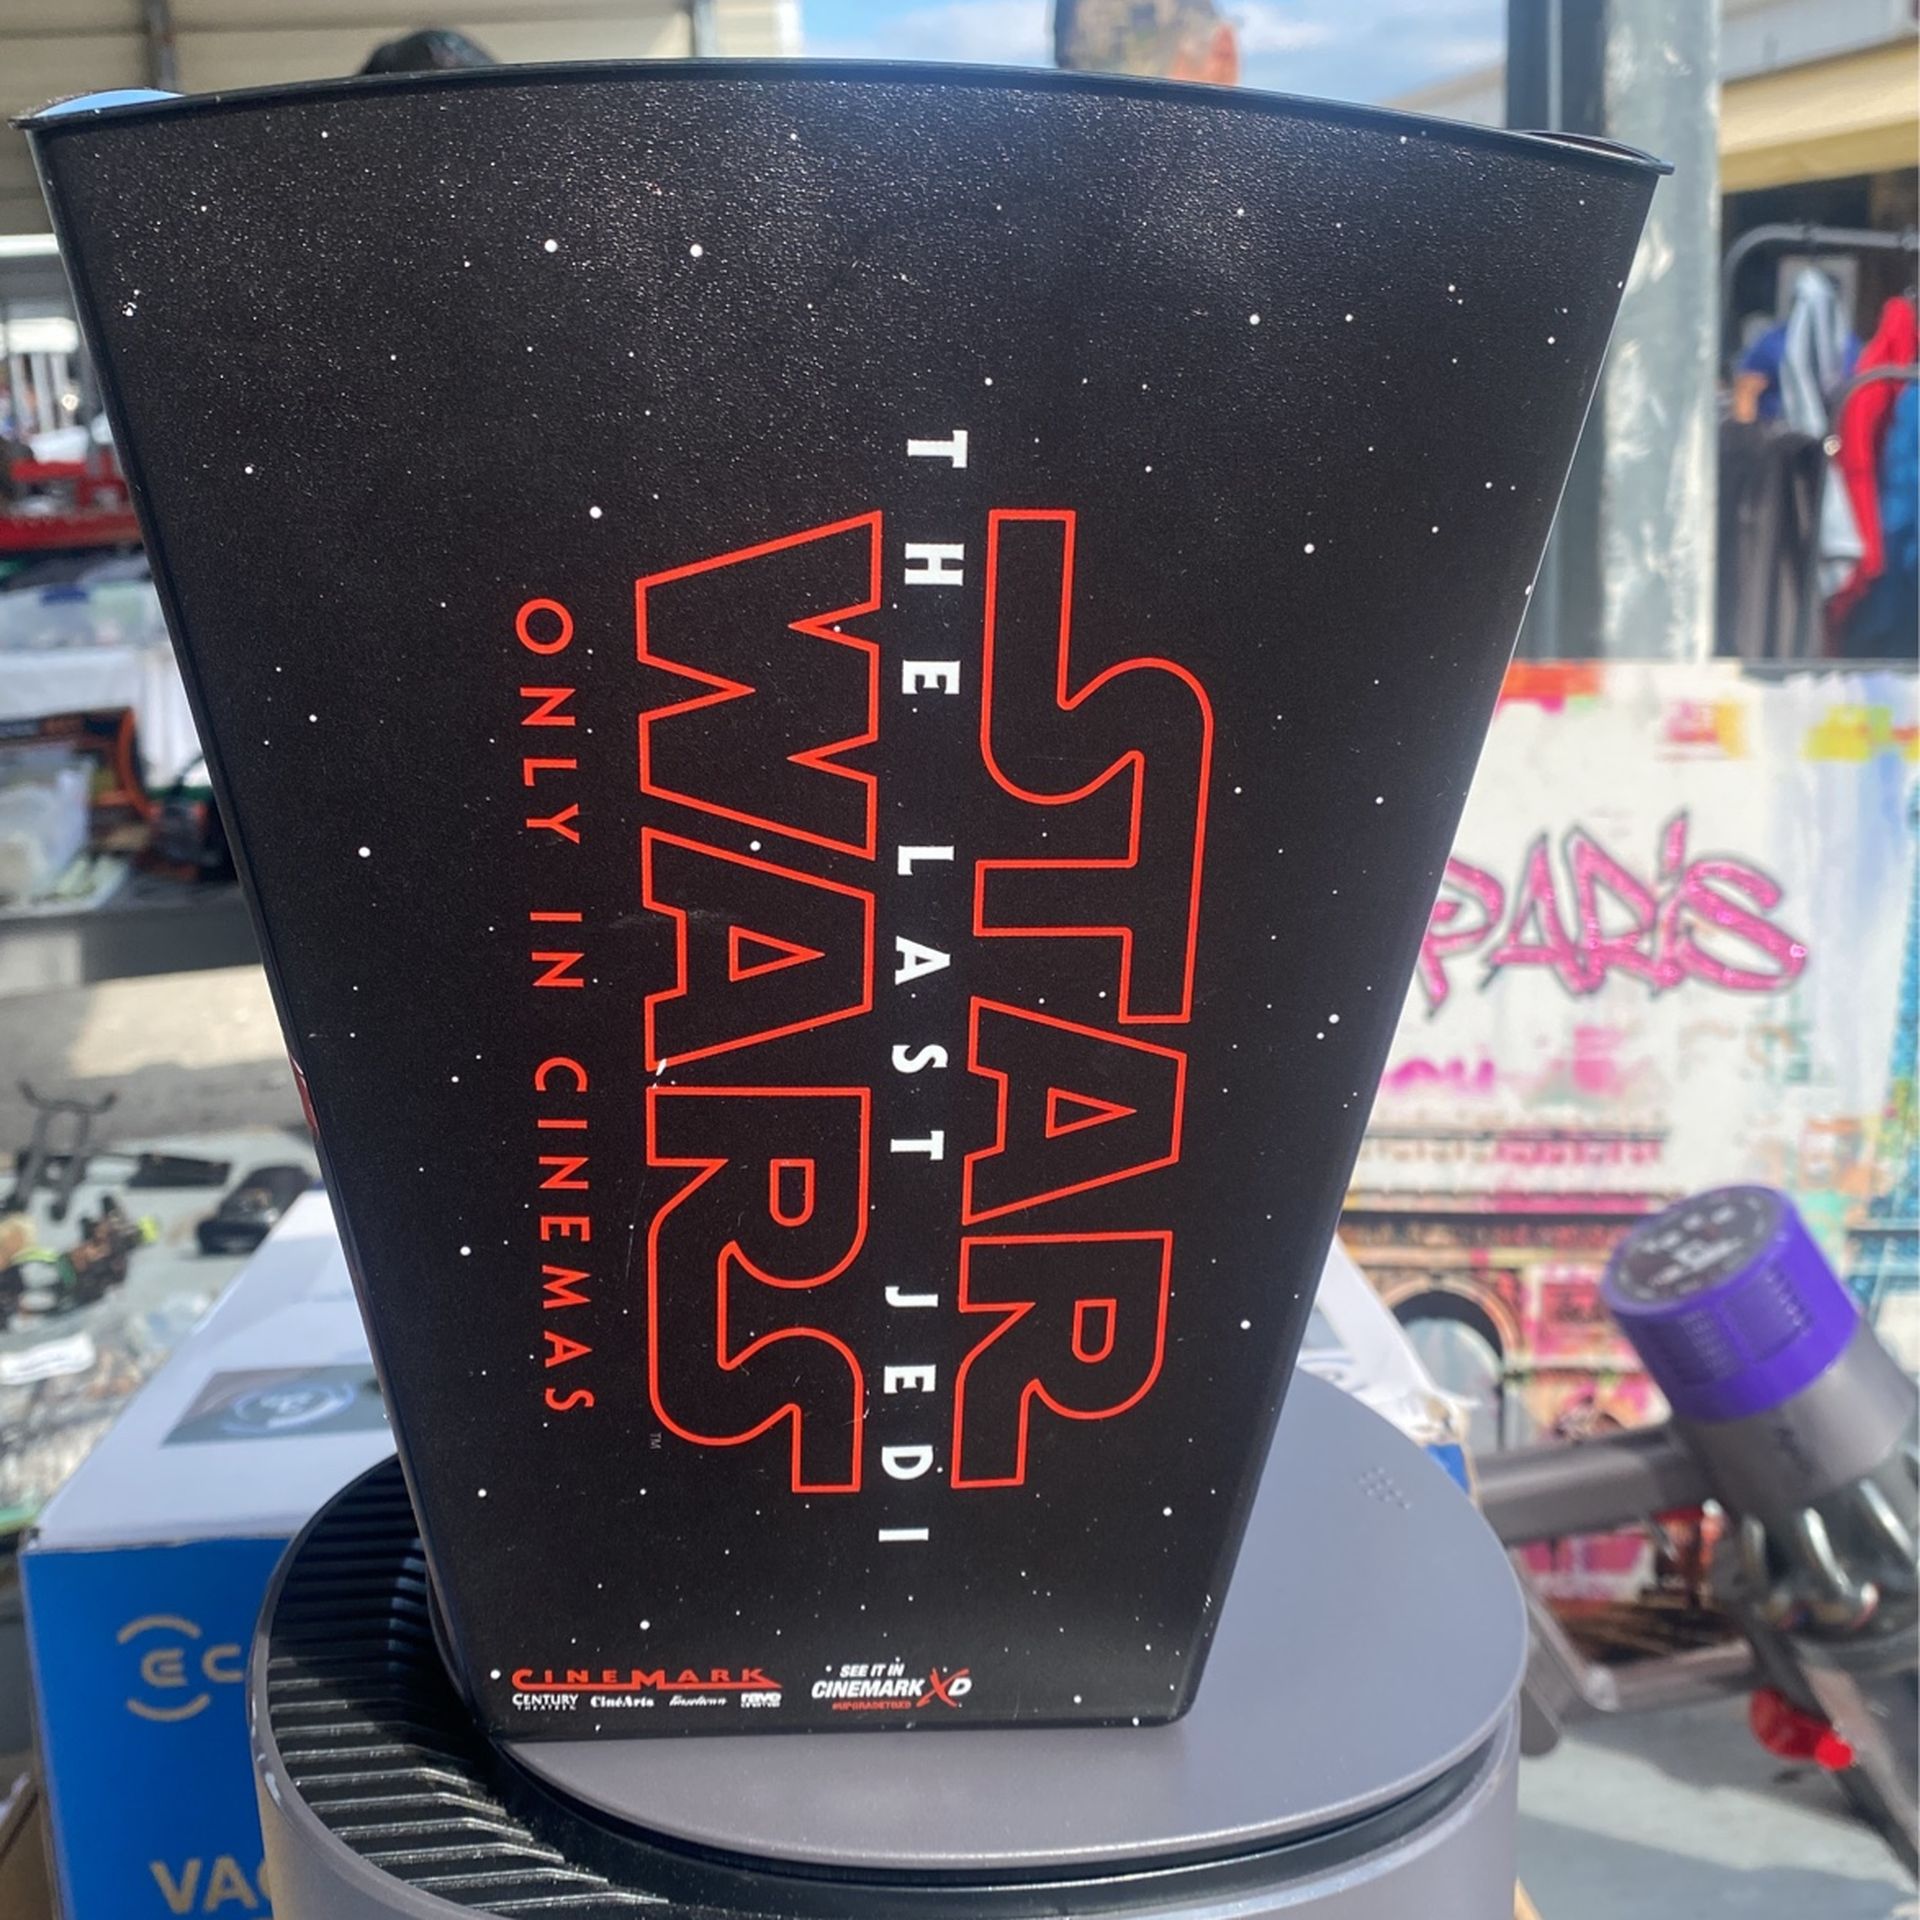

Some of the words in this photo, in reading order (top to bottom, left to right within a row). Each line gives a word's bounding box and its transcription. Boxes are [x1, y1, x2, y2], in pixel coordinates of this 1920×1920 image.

[903, 428, 969, 698] THE
[515, 597, 580, 845] ONLY
[530, 910, 584, 988] IN
[634, 509, 883, 1494] WARS
[890, 843, 955, 1162] LAST
[952, 508, 1215, 1489] STAR
[534, 1056, 595, 1412] CINEMAS
[877, 1285, 944, 1544] JEDI
[511, 1668, 782, 1692] CINEMARK
[512, 1693, 579, 1705] CENTURY
[811, 1678, 926, 1699] CINEMARK
[915, 1667, 972, 1709] XD
[840, 1664, 867, 1678] SEE
[870, 1663, 887, 1677] IT
[887, 1662, 905, 1677] IN
[150, 1853, 273, 1915] VA
